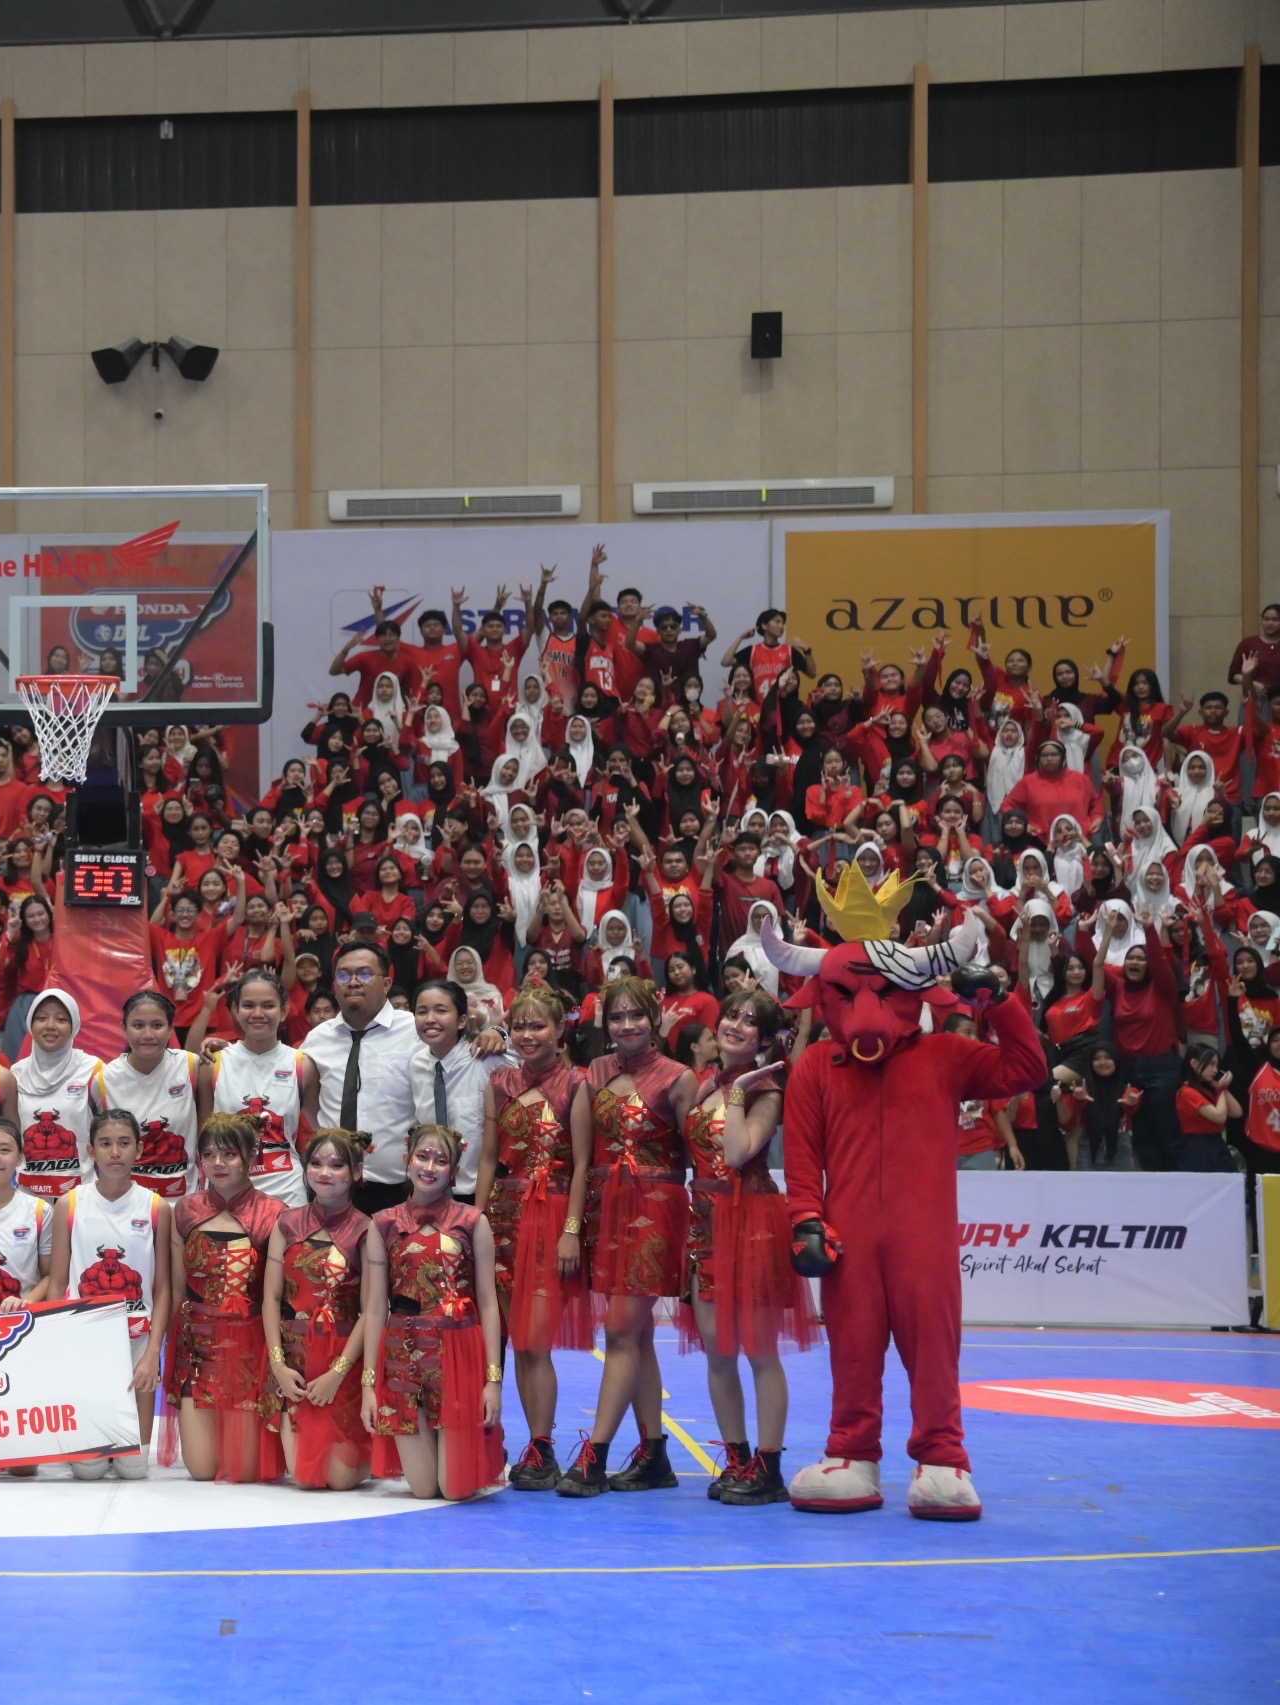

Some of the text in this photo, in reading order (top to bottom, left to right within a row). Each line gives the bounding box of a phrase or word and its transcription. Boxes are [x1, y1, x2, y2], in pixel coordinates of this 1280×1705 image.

[113, 625, 150, 641] DL
[74, 854, 137, 864] SHOT CLOCK
[1040, 1224, 1188, 1249] KALTIM
[960, 1254, 1107, 1279] Spirit Akal Sehat
[16, 1404, 78, 1436] FOUR
